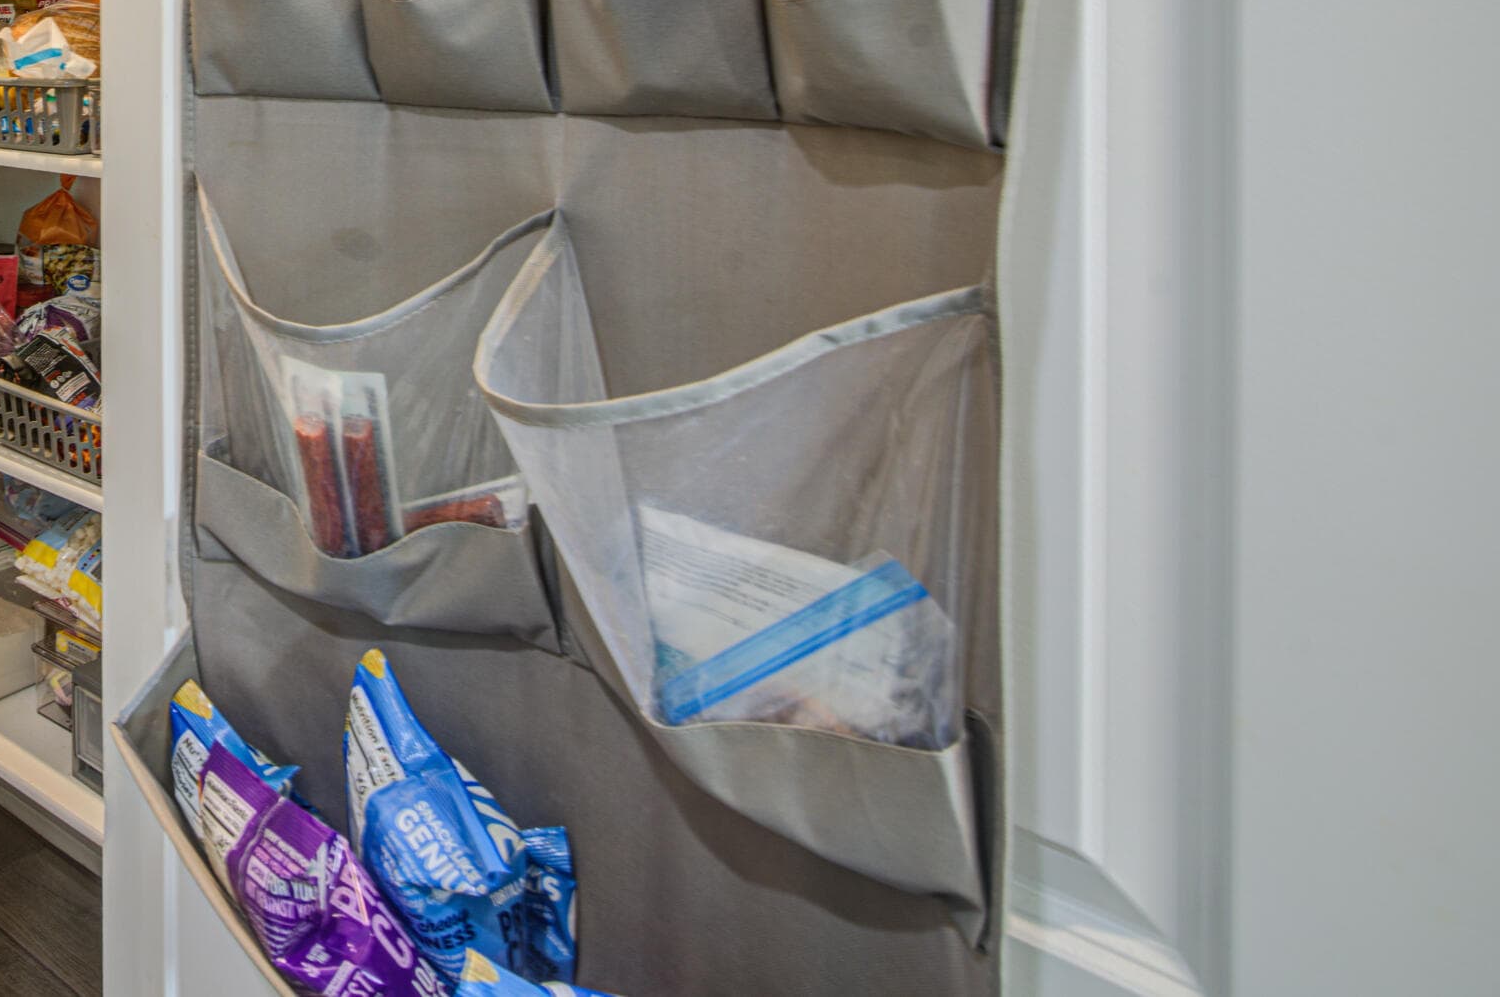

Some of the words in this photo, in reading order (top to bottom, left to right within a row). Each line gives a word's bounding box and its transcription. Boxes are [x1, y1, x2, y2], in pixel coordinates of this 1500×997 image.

[376, 746, 398, 781] Fact
[394, 808, 463, 893] GENIU
[414, 800, 457, 853] SNACK
[453, 848, 485, 887] LIKE
